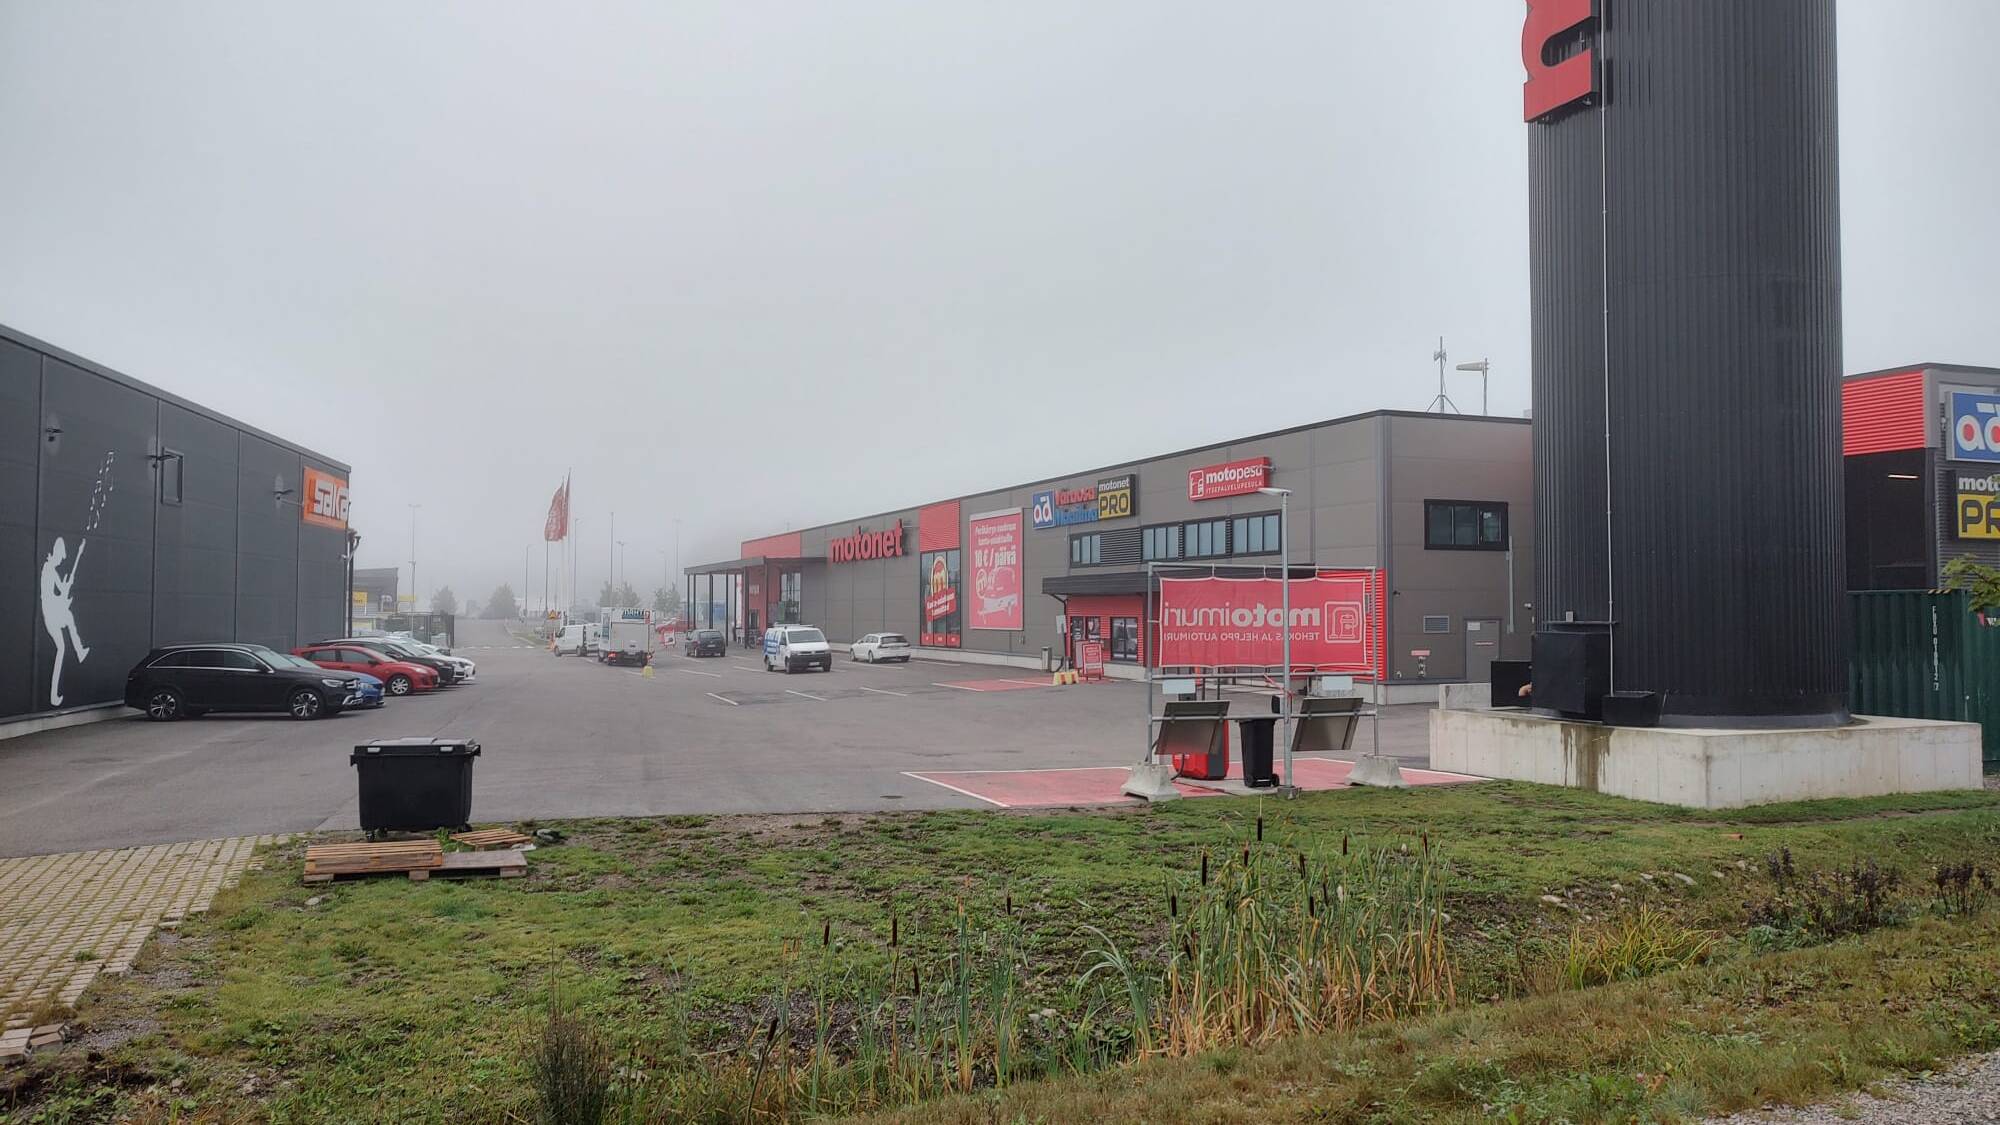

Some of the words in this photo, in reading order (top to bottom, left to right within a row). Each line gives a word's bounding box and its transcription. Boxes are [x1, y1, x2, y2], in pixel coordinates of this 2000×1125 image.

[1098, 477, 1129, 491] motonet
[1099, 493, 1129, 516] PRO
[830, 518, 903, 562] motonet
